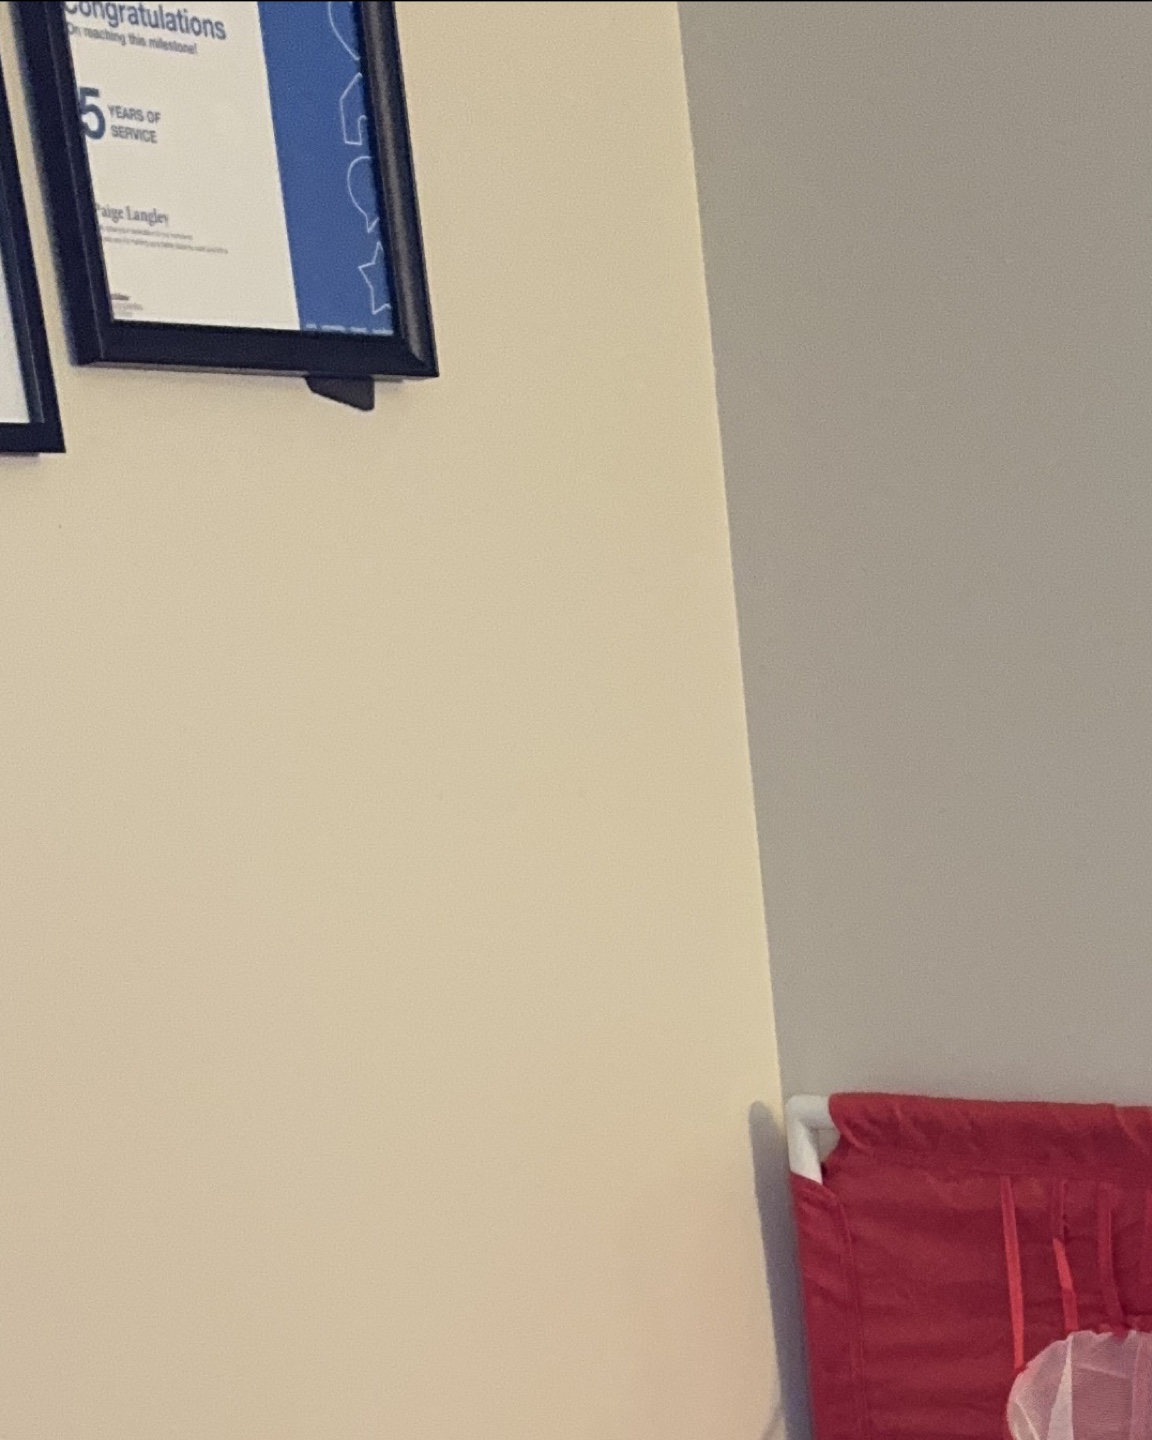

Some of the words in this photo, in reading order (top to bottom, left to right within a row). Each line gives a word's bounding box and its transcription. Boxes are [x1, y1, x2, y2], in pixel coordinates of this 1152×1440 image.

[83, 27, 126, 46] reaching
[128, 33, 146, 47] this
[79, 86, 106, 140] 5
[107, 104, 144, 122] YEARS
[146, 110, 161, 125] OF
[110, 125, 158, 144] SERVICE
